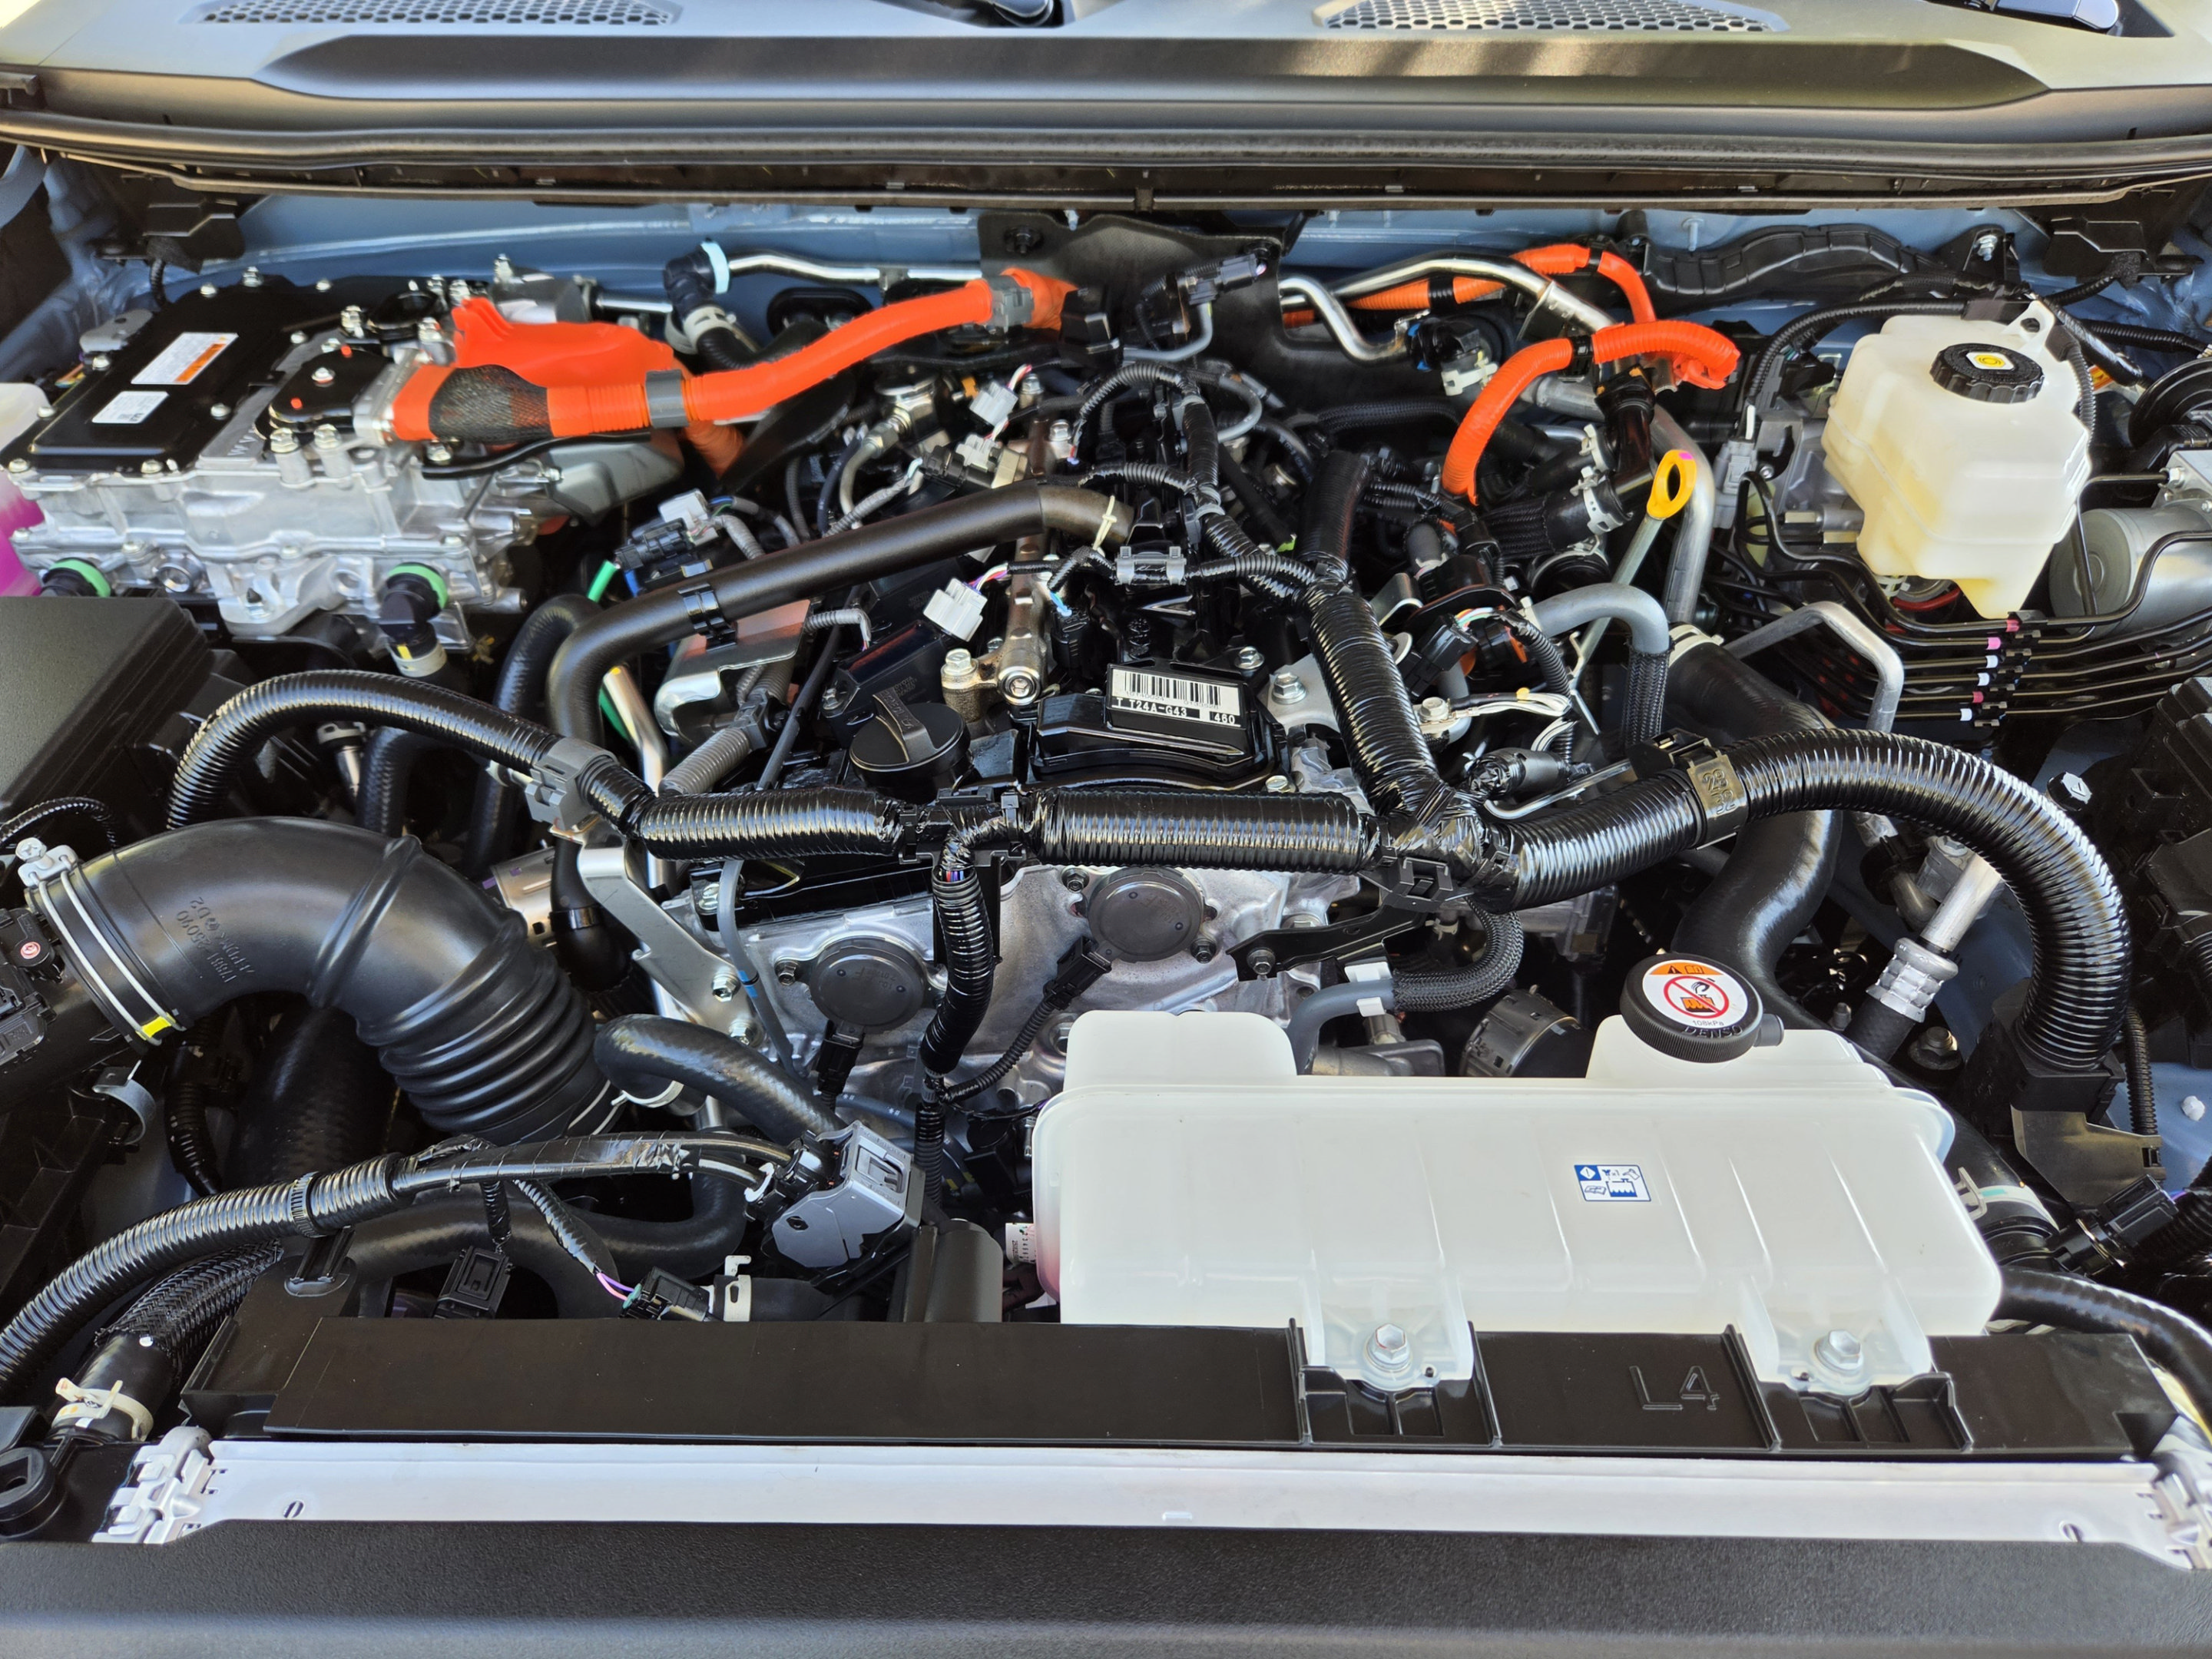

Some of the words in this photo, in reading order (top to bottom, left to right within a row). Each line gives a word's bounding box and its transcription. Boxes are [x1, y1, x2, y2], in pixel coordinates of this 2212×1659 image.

[1116, 697, 1124, 707] T
[1129, 700, 1187, 717] T24A-G43
[1214, 713, 1236, 724] 460
[1702, 768, 1728, 791] 28
[1683, 1024, 1743, 1038] DENSO
[1629, 1366, 1720, 1410] L4
